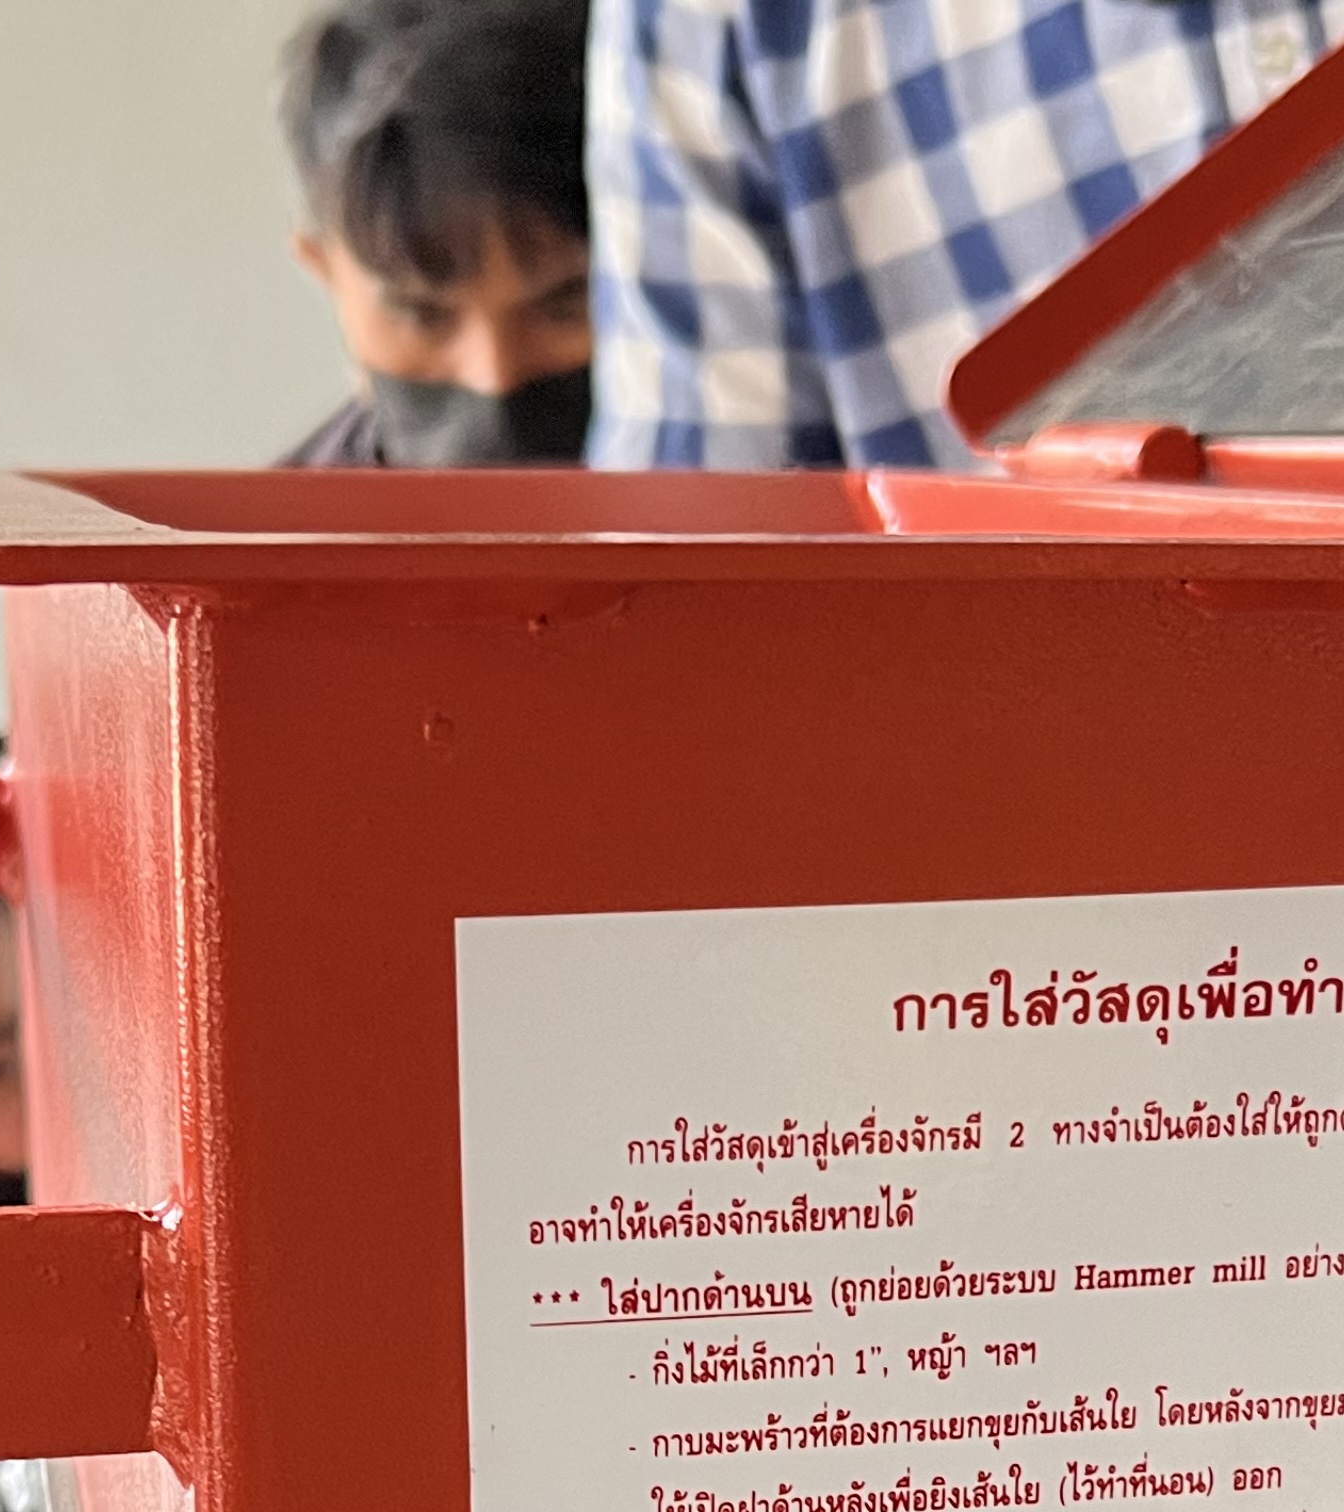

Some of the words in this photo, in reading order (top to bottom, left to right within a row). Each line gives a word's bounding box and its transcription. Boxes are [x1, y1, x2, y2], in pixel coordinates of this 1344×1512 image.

[1008, 1120, 1025, 1149] 2
[600, 1270, 814, 1317] ใส่ปากด้านบน
[829, 1258, 1057, 1317] (ถูกย่อยด้วยระบบ
[1073, 1262, 1196, 1291] Hammer
[1211, 1253, 1267, 1284] mill
[651, 1336, 835, 1385] กิ่งไม้ที่เล็กกว่า
[905, 1330, 966, 1381] หญ้า
[983, 1340, 1037, 1366] ฯลฯ
[1058, 1452, 1215, 1506] (ไว้ทำที่นอน)
[1232, 1465, 1283, 1492] ออก
